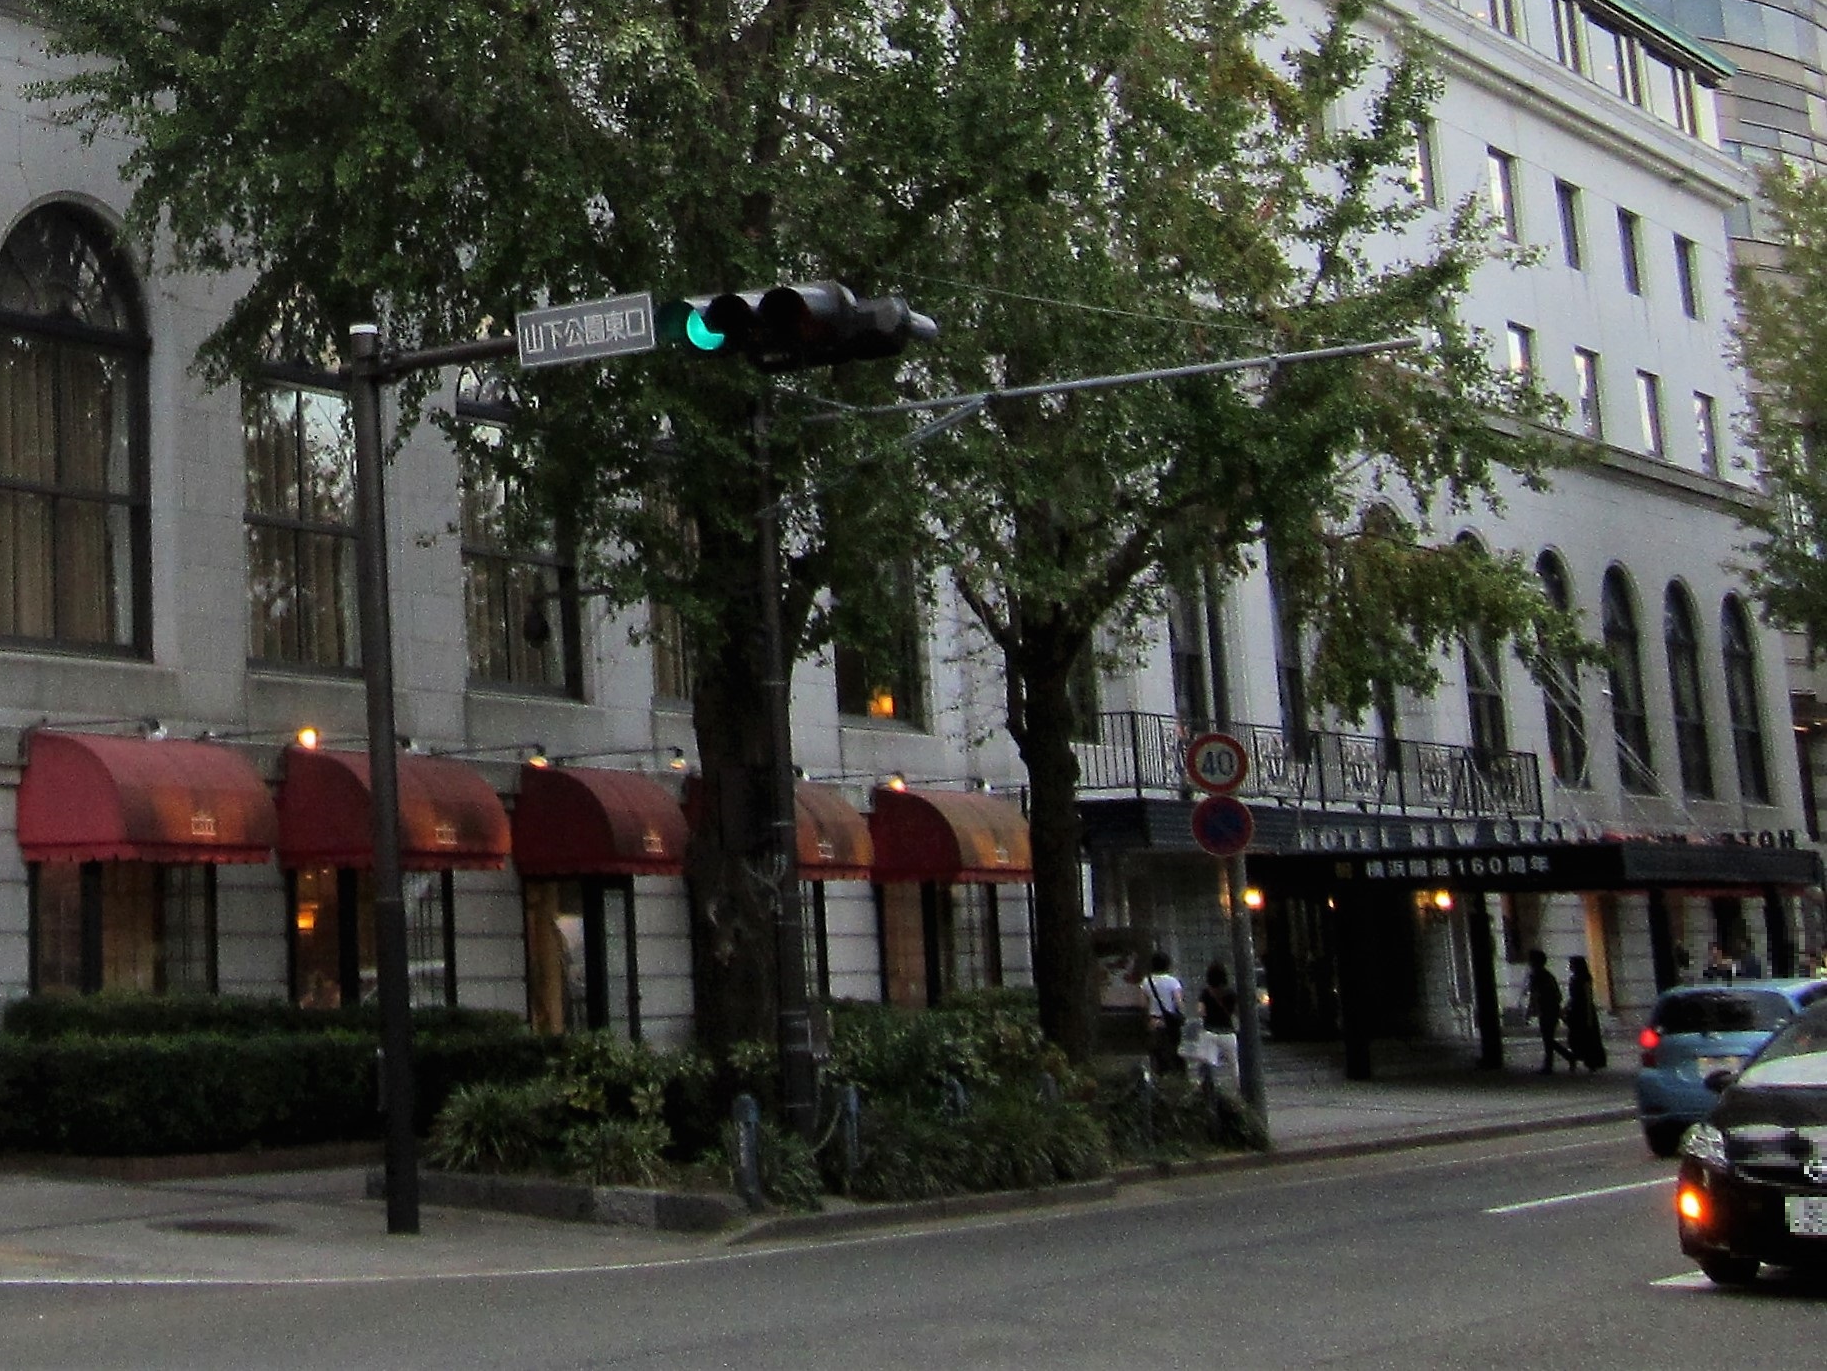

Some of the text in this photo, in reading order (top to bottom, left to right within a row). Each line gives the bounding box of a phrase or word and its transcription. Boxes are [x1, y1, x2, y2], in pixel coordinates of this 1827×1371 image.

[524, 307, 646, 354] 山下公園東口
[1202, 750, 1234, 777] 40
[1298, 826, 1397, 851] HOTEL
[1410, 822, 1477, 847] NEW
